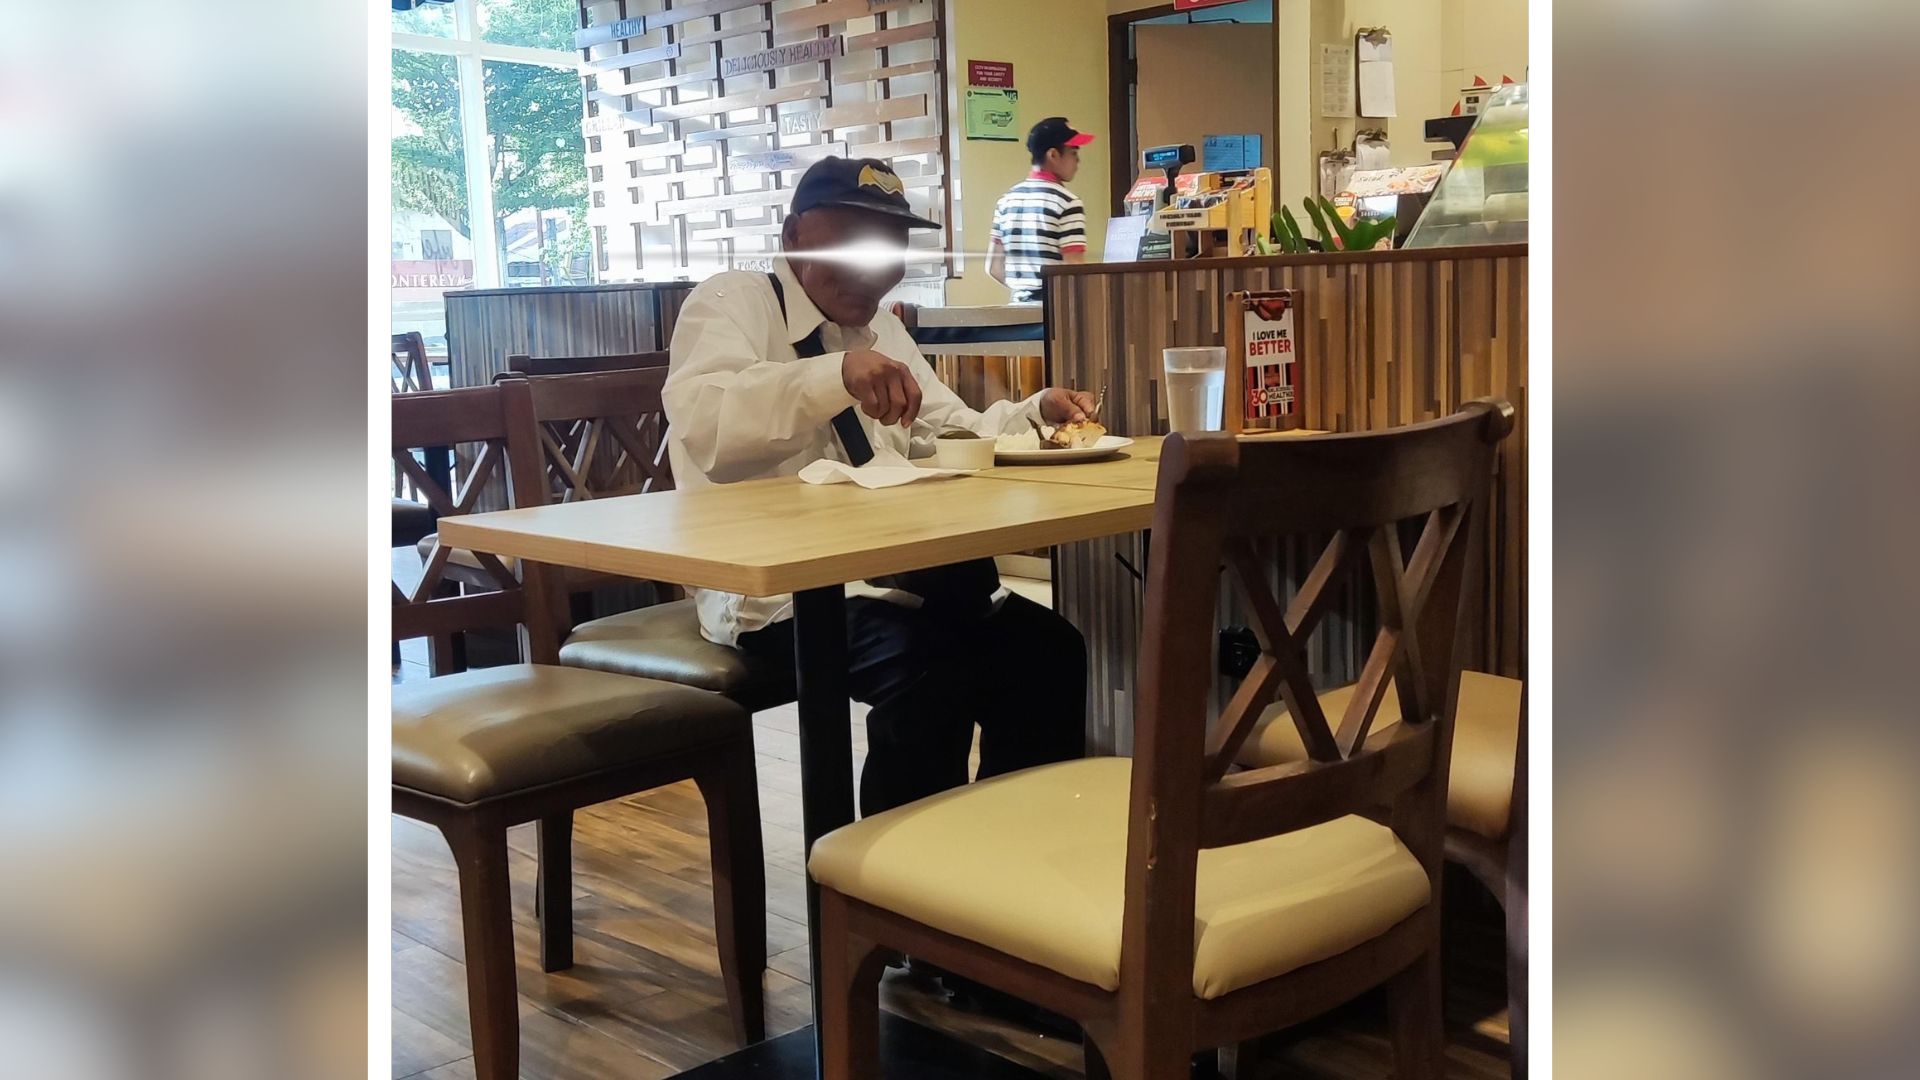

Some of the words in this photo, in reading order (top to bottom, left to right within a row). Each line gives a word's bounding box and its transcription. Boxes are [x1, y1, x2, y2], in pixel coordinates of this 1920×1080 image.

[610, 16, 641, 39] HEALTHY
[725, 48, 787, 76] DELICIOUSLY
[789, 38, 837, 64] HEALTHY
[784, 111, 824, 134] TASTY
[1257, 330, 1275, 340] LOVE
[1276, 329, 1287, 339] ME
[1249, 339, 1292, 356] BETTER
